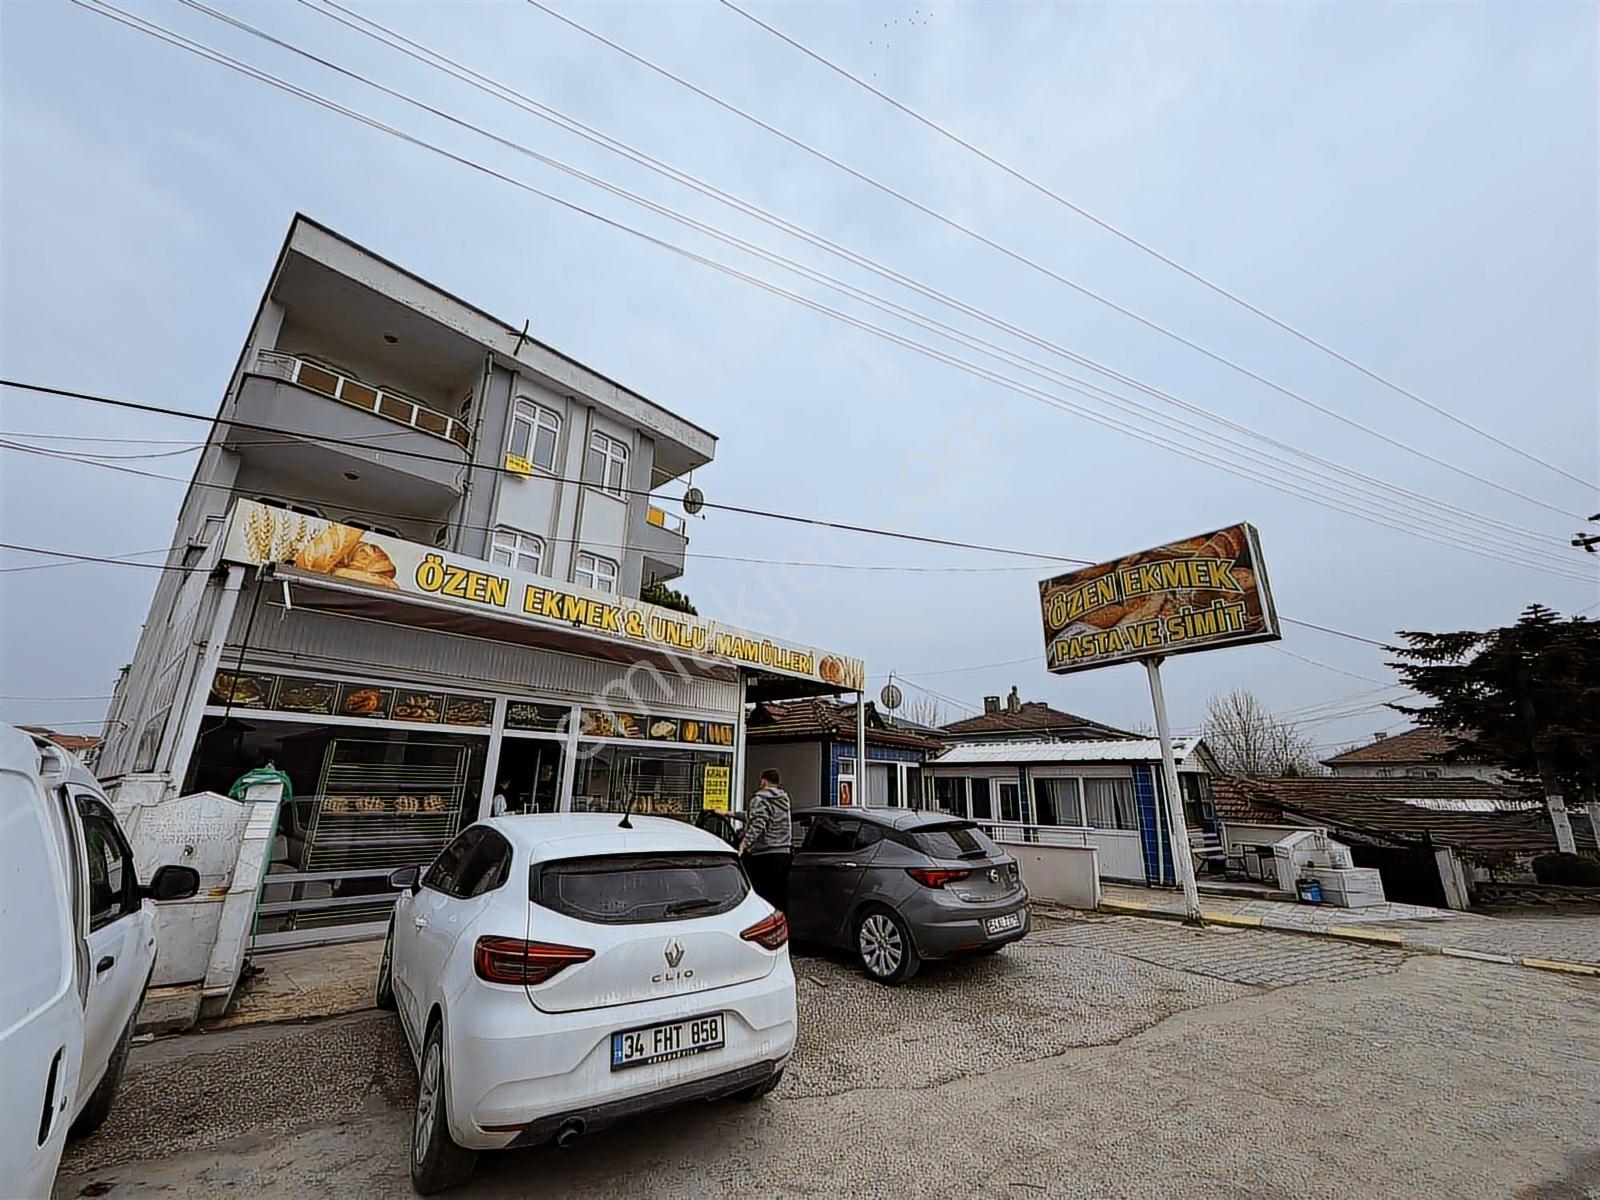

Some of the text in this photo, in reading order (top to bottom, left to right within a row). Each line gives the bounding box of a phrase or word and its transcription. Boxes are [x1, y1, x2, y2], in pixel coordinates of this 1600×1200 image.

[416, 553, 510, 607] ÖZEN
[523, 585, 620, 633] EKMEK
[625, 610, 645, 637] &
[651, 616, 706, 650] UNLU
[1051, 558, 1243, 629] ÖZEN EKMEK
[1055, 601, 1244, 662] PASTA VE SİMİT
[651, 969, 694, 983] CLIO
[624, 1033, 645, 1059] 34
[653, 1025, 683, 1053] FHT
[691, 1018, 719, 1045] 858
